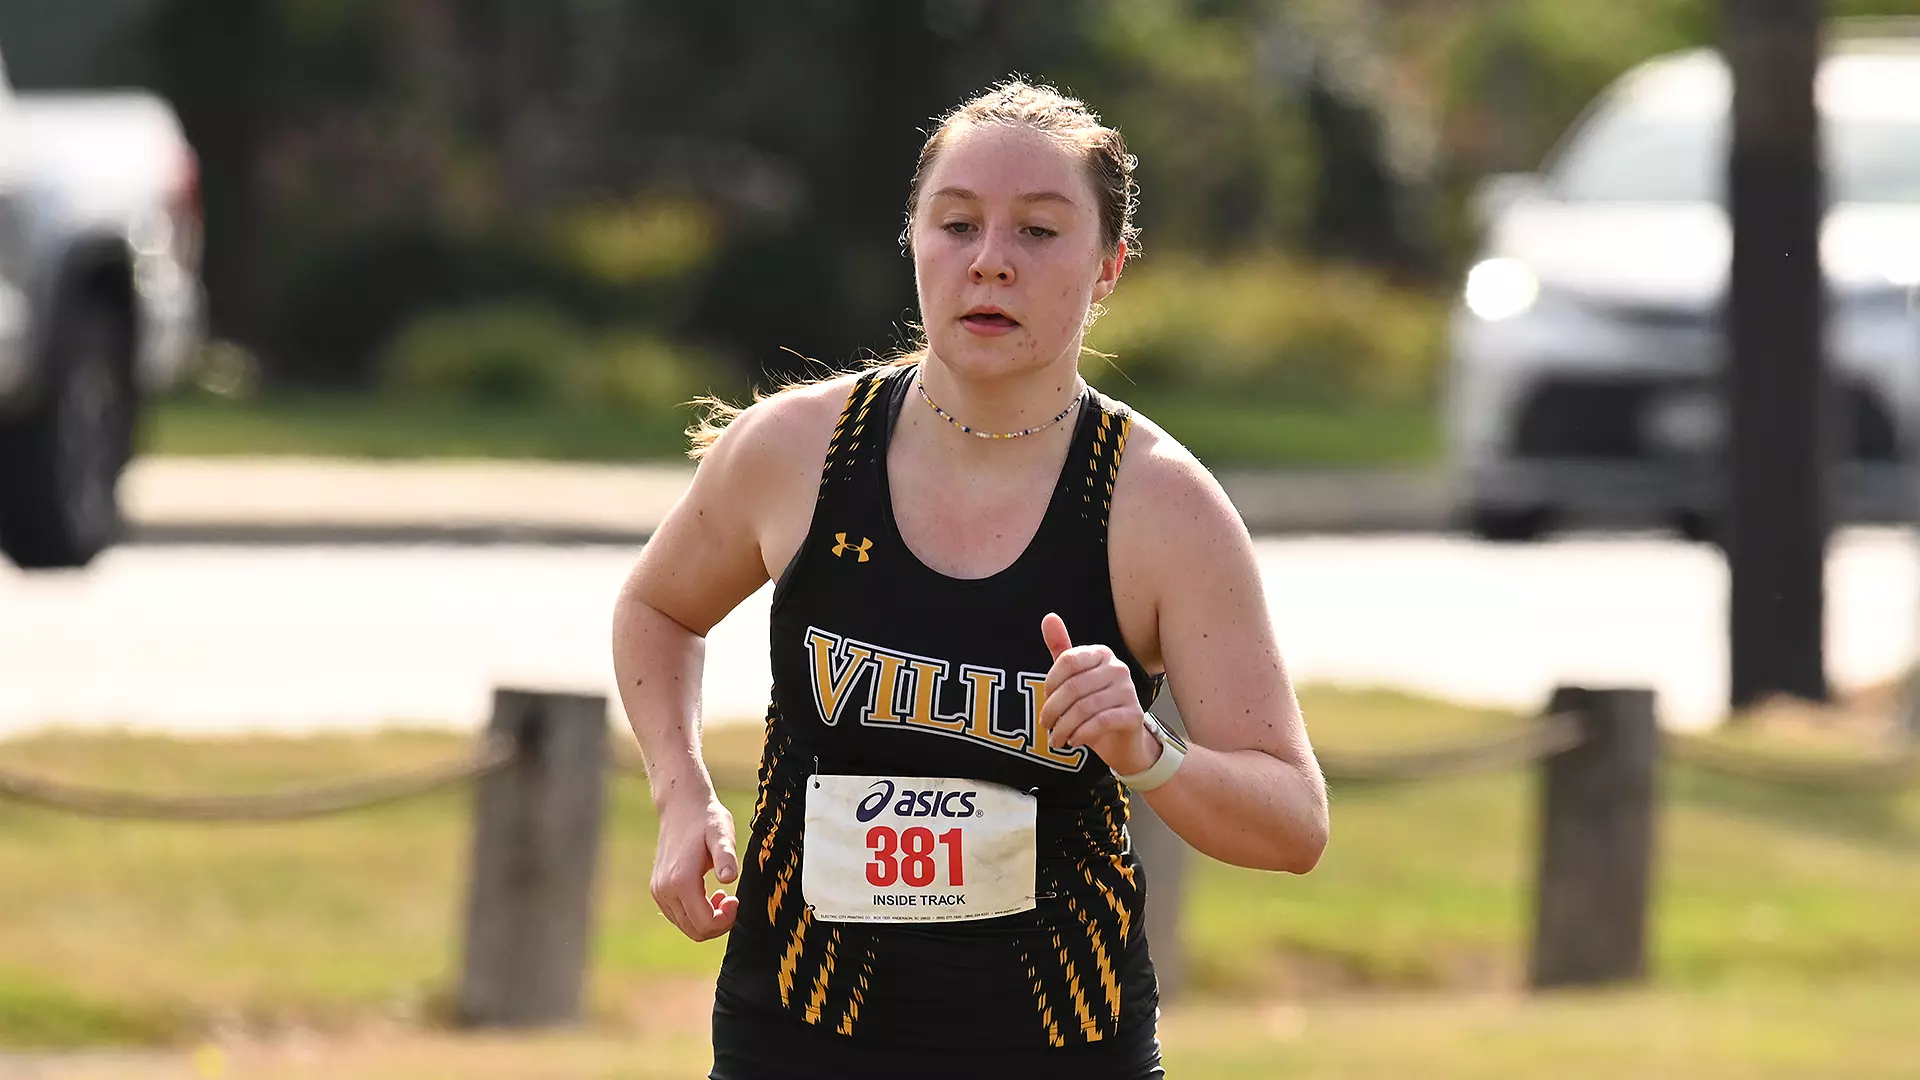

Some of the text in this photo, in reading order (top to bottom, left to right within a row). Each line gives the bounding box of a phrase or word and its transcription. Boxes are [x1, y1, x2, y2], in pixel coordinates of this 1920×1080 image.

[894, 790, 977, 818] asics
[865, 826, 964, 888] 381
[873, 894, 966, 906] INSIDE TRACK
